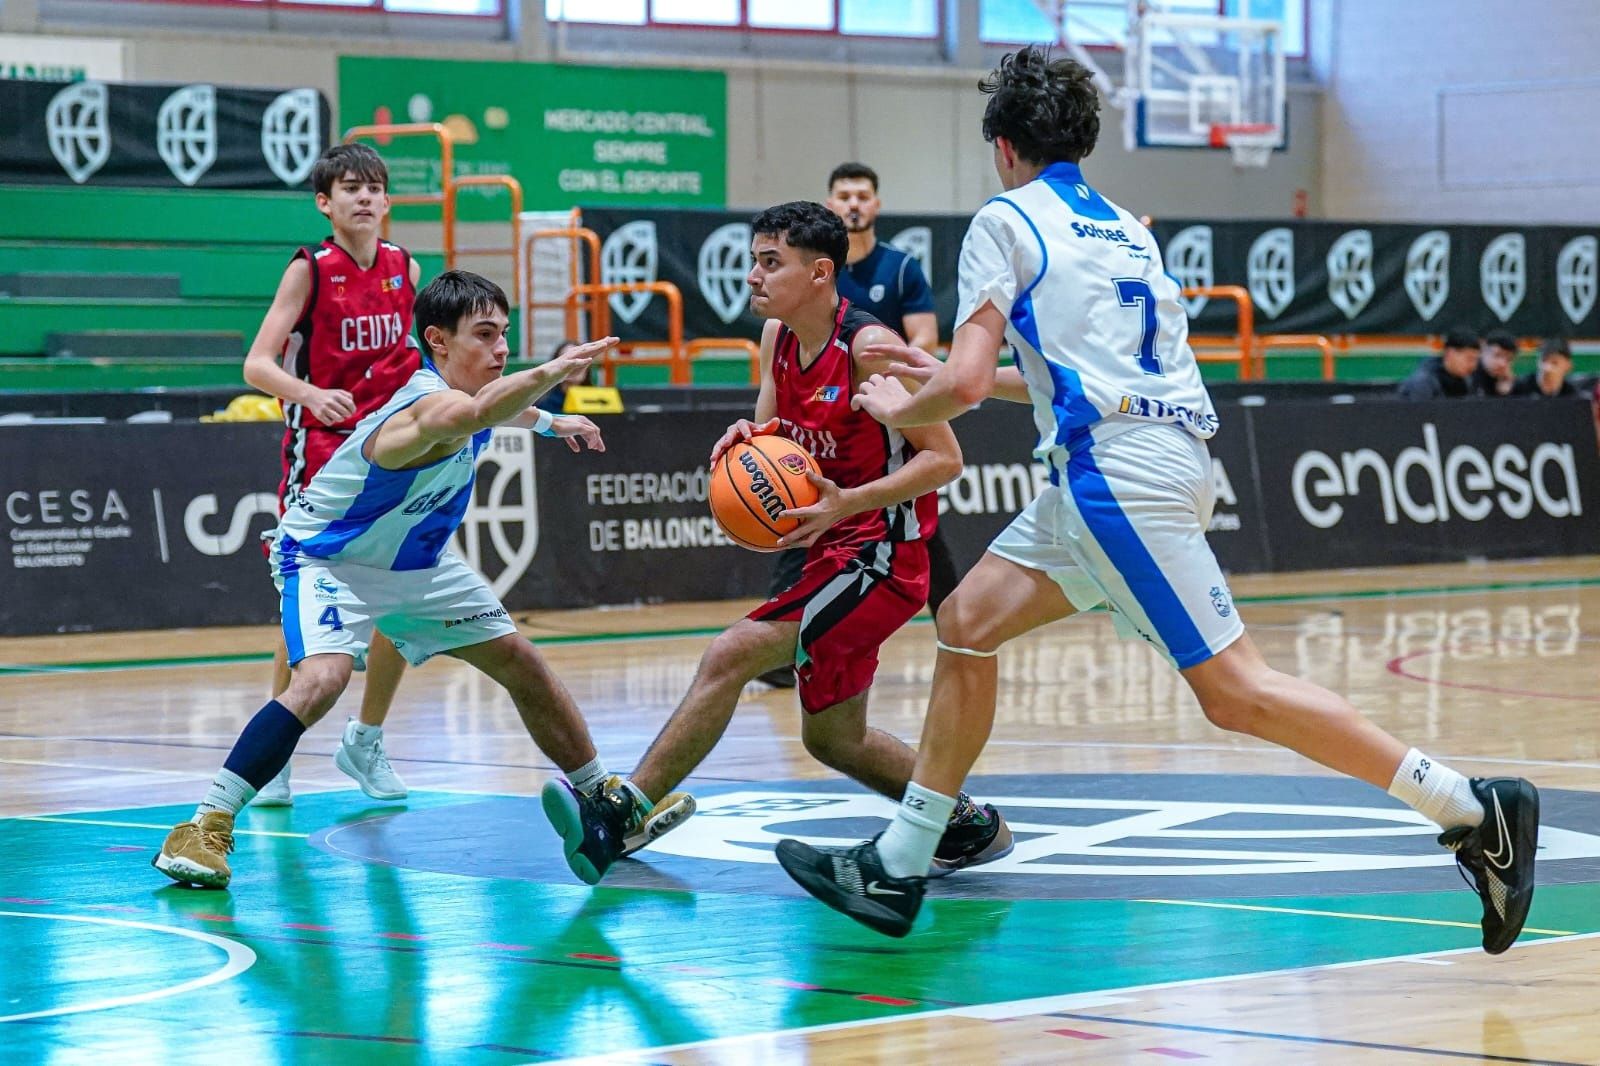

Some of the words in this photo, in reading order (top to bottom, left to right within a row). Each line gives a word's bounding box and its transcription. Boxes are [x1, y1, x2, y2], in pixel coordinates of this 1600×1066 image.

[341, 312, 402, 351] CEUTA
[1111, 276, 1166, 378] 7
[587, 464, 711, 505] FEDERACIÓ
[1291, 422, 1582, 528] endesa
[6, 488, 130, 525] CESA
[589, 519, 621, 551] DE
[318, 603, 343, 632] 4
[1413, 758, 1431, 785] 23
